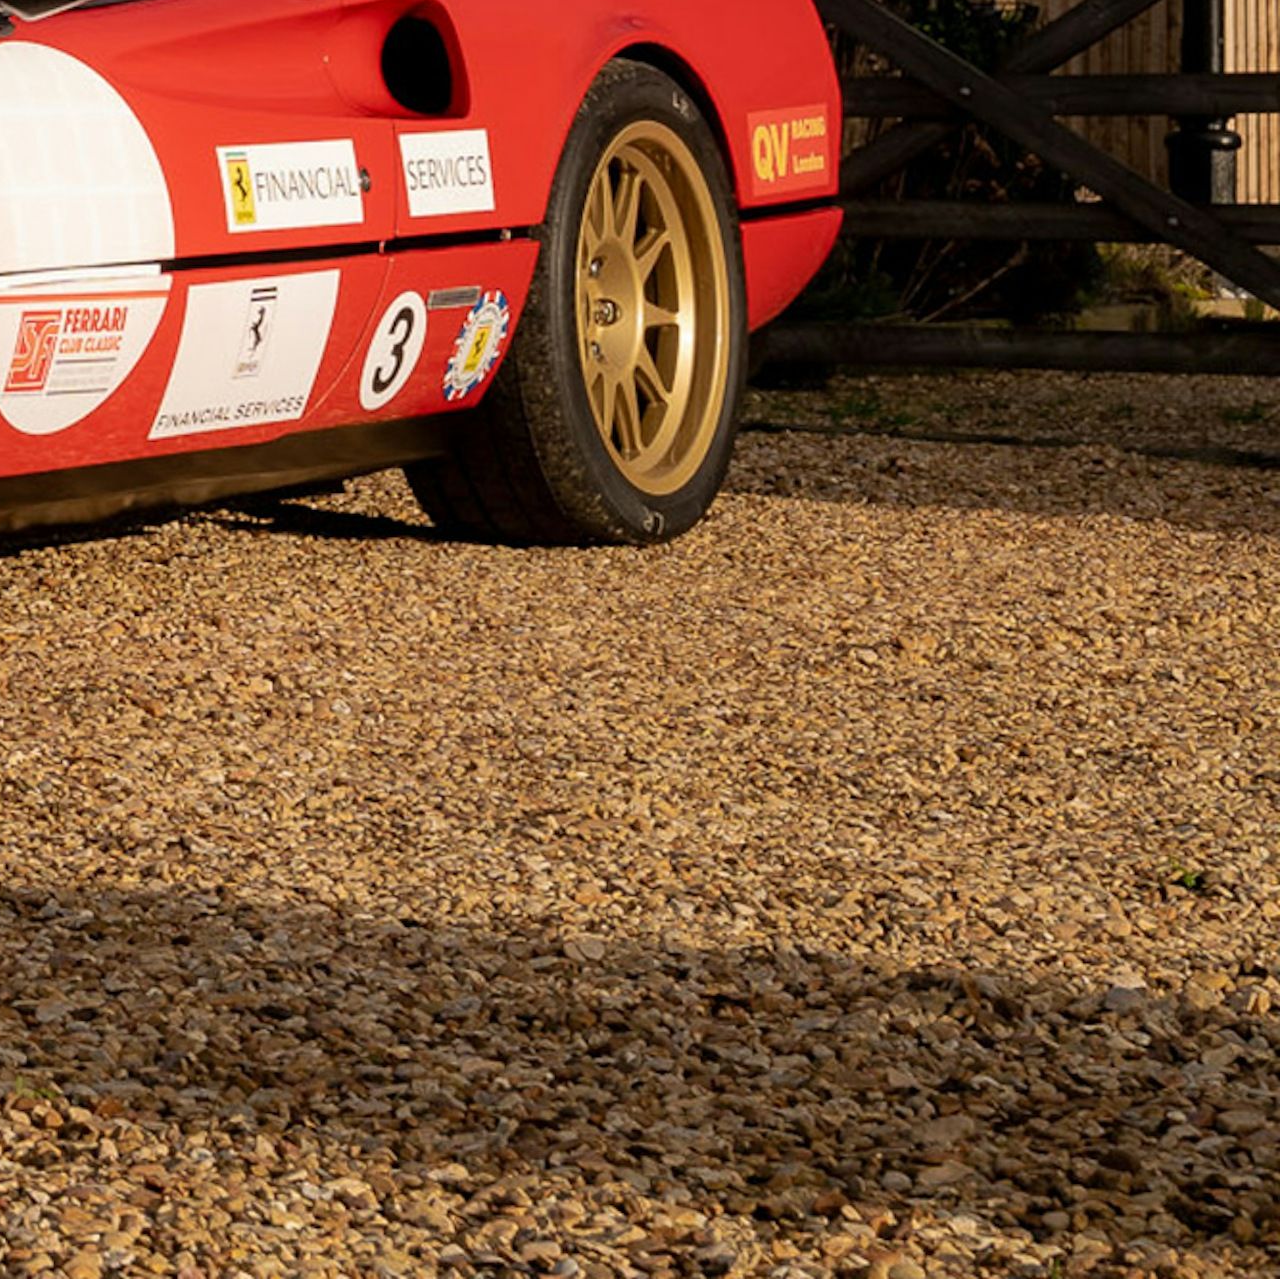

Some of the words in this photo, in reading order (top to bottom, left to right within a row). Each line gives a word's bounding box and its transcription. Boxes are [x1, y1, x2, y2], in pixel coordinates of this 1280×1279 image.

[753, 123, 789, 182] QV
[254, 167, 358, 202] FINANCIAL
[406, 156, 487, 190] SERVICES
[63, 306, 128, 333] FERRARI
[372, 307, 415, 394] 3
[156, 406, 229, 430] FINANCIAL
[234, 395, 304, 420] SERVICES
